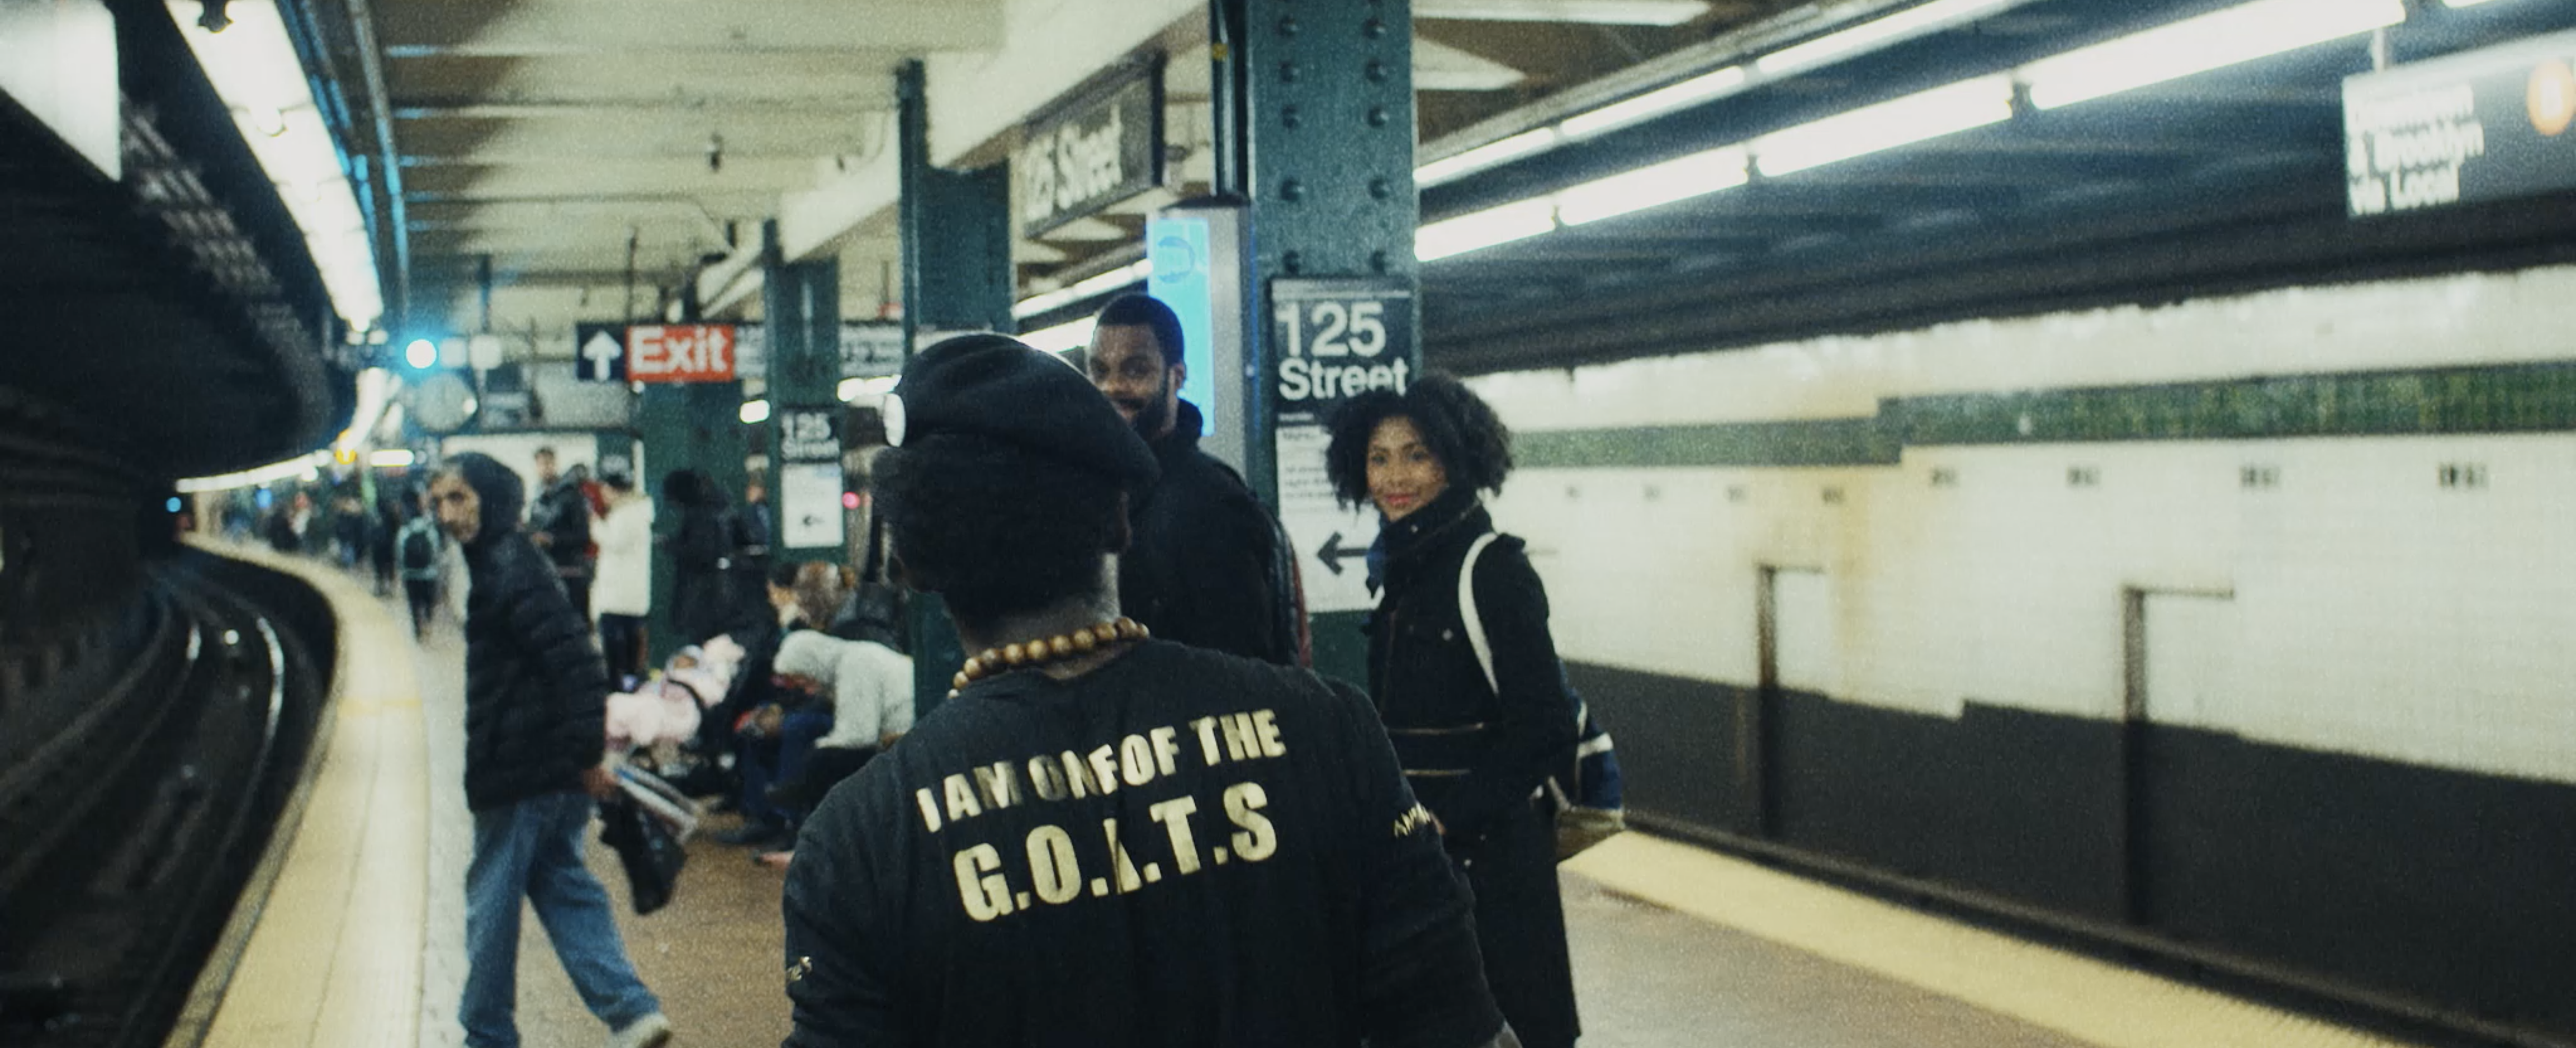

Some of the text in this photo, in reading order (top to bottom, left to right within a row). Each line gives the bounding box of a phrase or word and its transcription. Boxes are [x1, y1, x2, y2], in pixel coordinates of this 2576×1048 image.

[631, 326, 730, 372] Exit
[1275, 301, 1386, 357] 125
[1279, 357, 1409, 400] Street
[782, 412, 831, 438] 125
[916, 787, 943, 833] I
[943, 760, 1024, 822] AM
[1120, 726, 1180, 786] OF
[1188, 708, 1287, 767] THE
